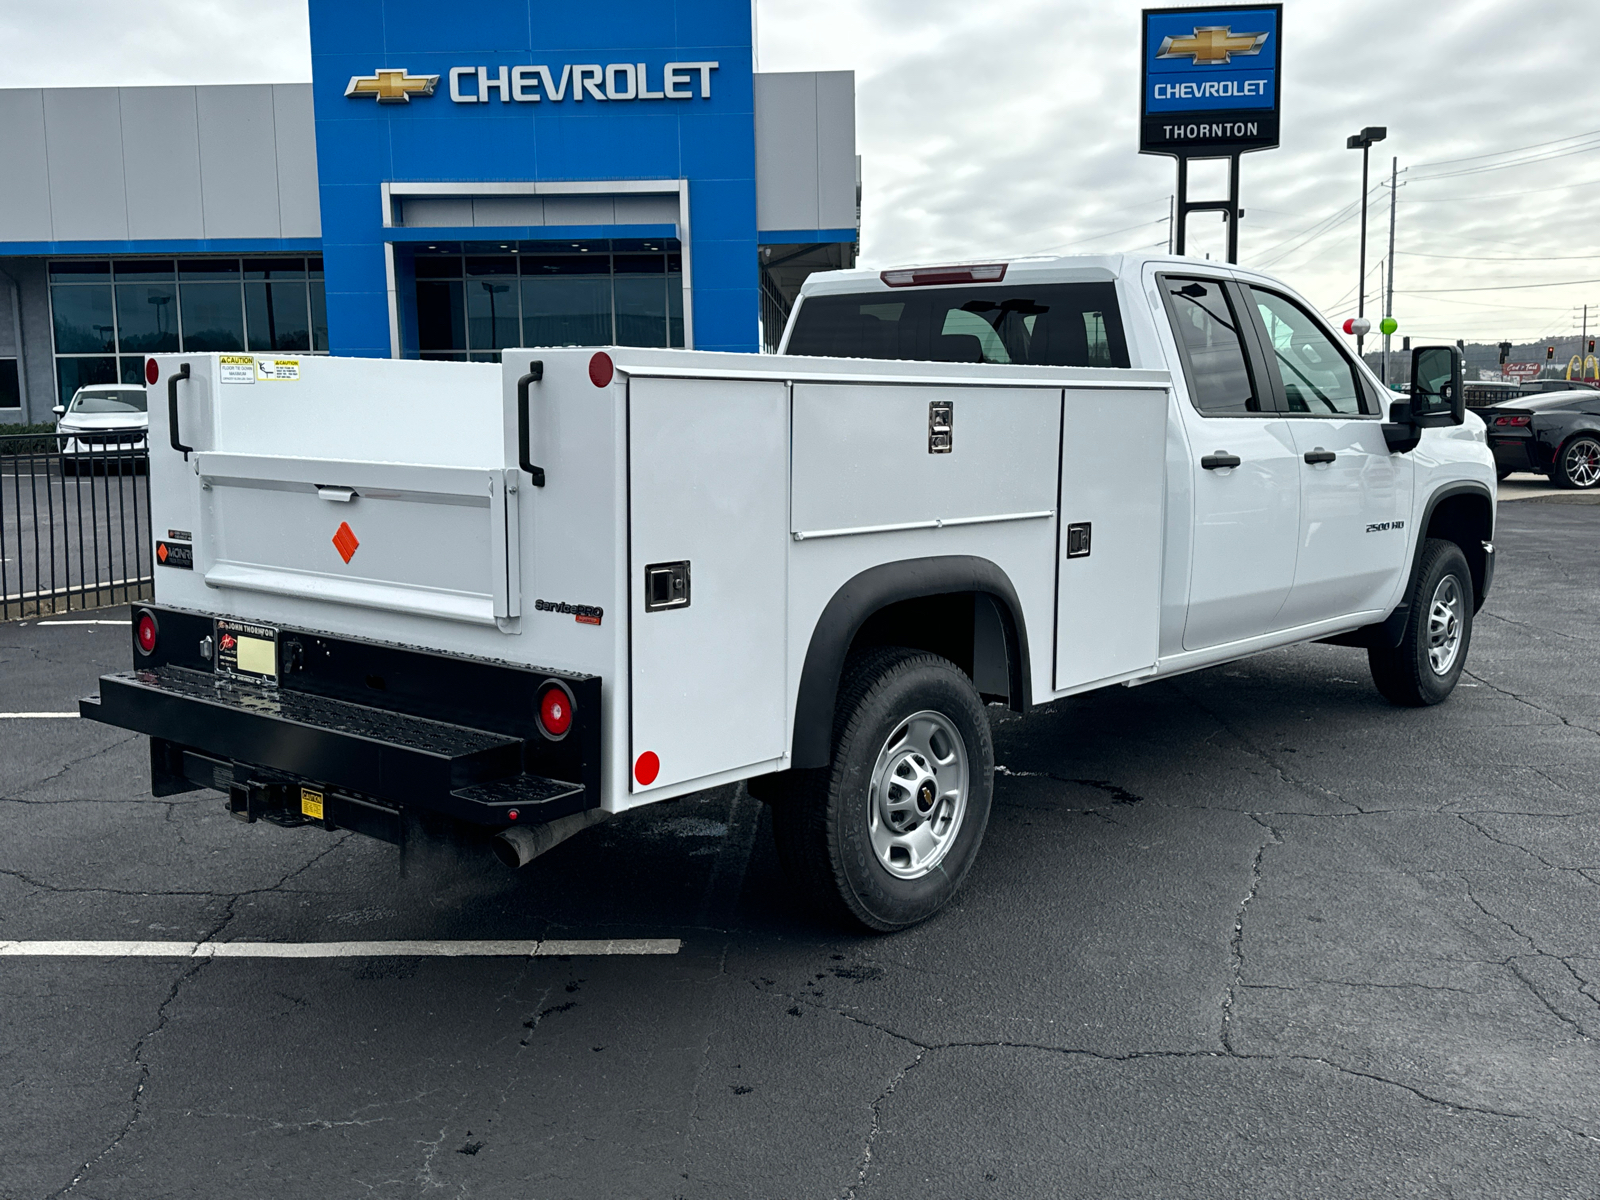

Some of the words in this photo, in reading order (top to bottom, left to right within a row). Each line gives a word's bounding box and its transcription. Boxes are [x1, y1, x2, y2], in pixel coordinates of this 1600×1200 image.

[449, 61, 719, 103] CHEVROLET
[1154, 79, 1268, 99] CHEVROLET
[1163, 122, 1258, 139] THORNTON
[1366, 522, 1390, 533] 2500
[1391, 521, 1405, 530] HD
[535, 599, 604, 618] ServicePRO
[229, 622, 243, 631] JOHN
[243, 625, 274, 637] THORNTON
